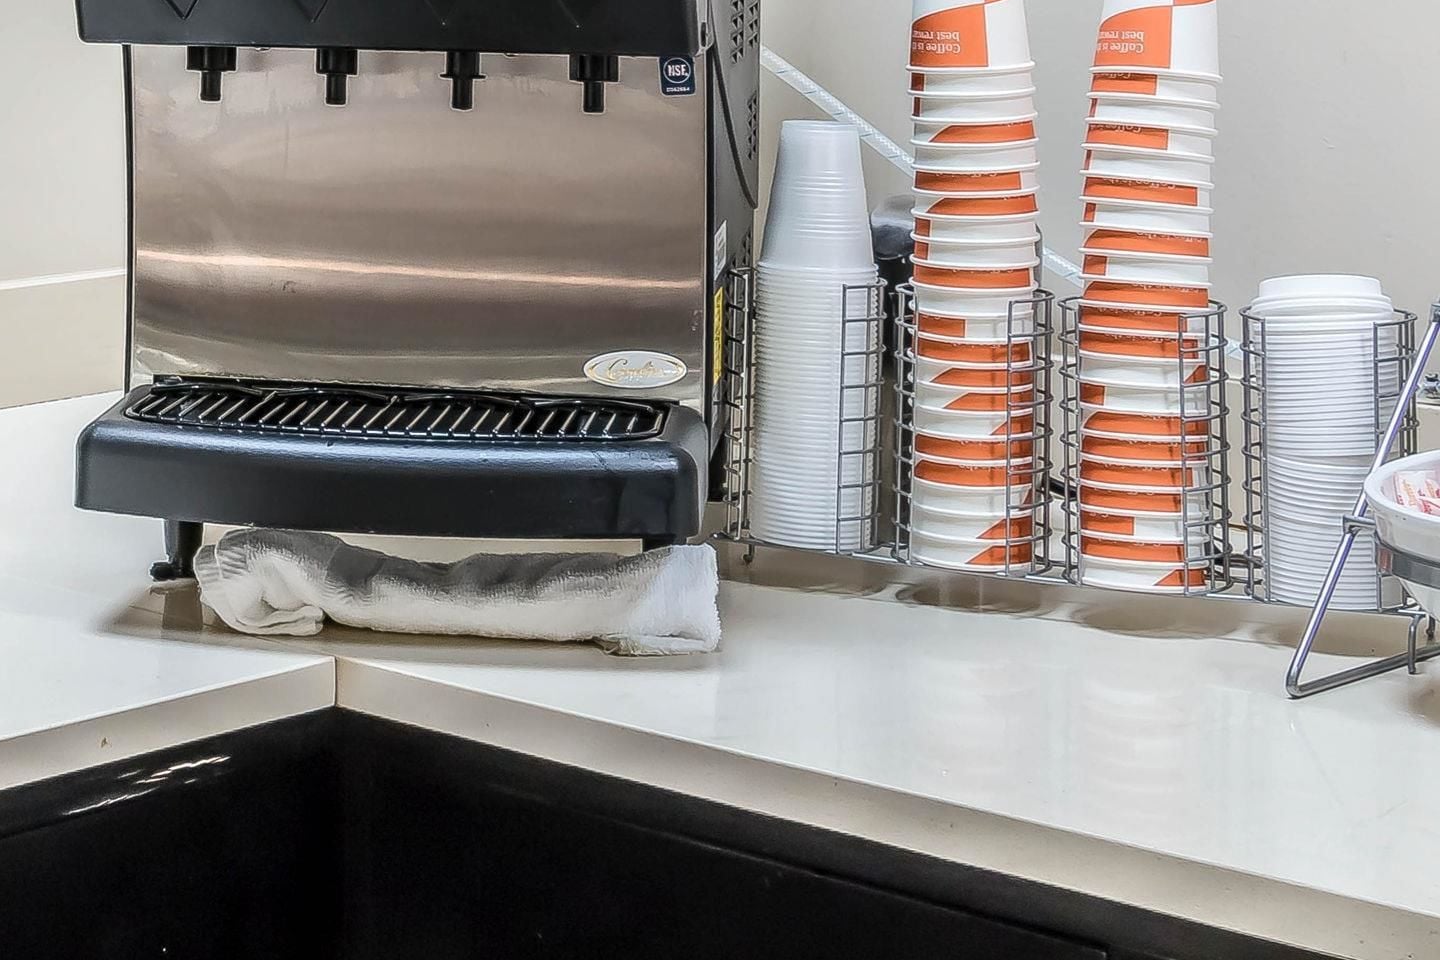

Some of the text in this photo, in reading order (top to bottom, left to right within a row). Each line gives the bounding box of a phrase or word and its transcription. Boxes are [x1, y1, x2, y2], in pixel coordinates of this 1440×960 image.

[936, 31, 960, 42] best
[1121, 31, 1145, 42] best
[926, 43, 961, 54] Coffee
[1109, 42, 1144, 53] Coffee
